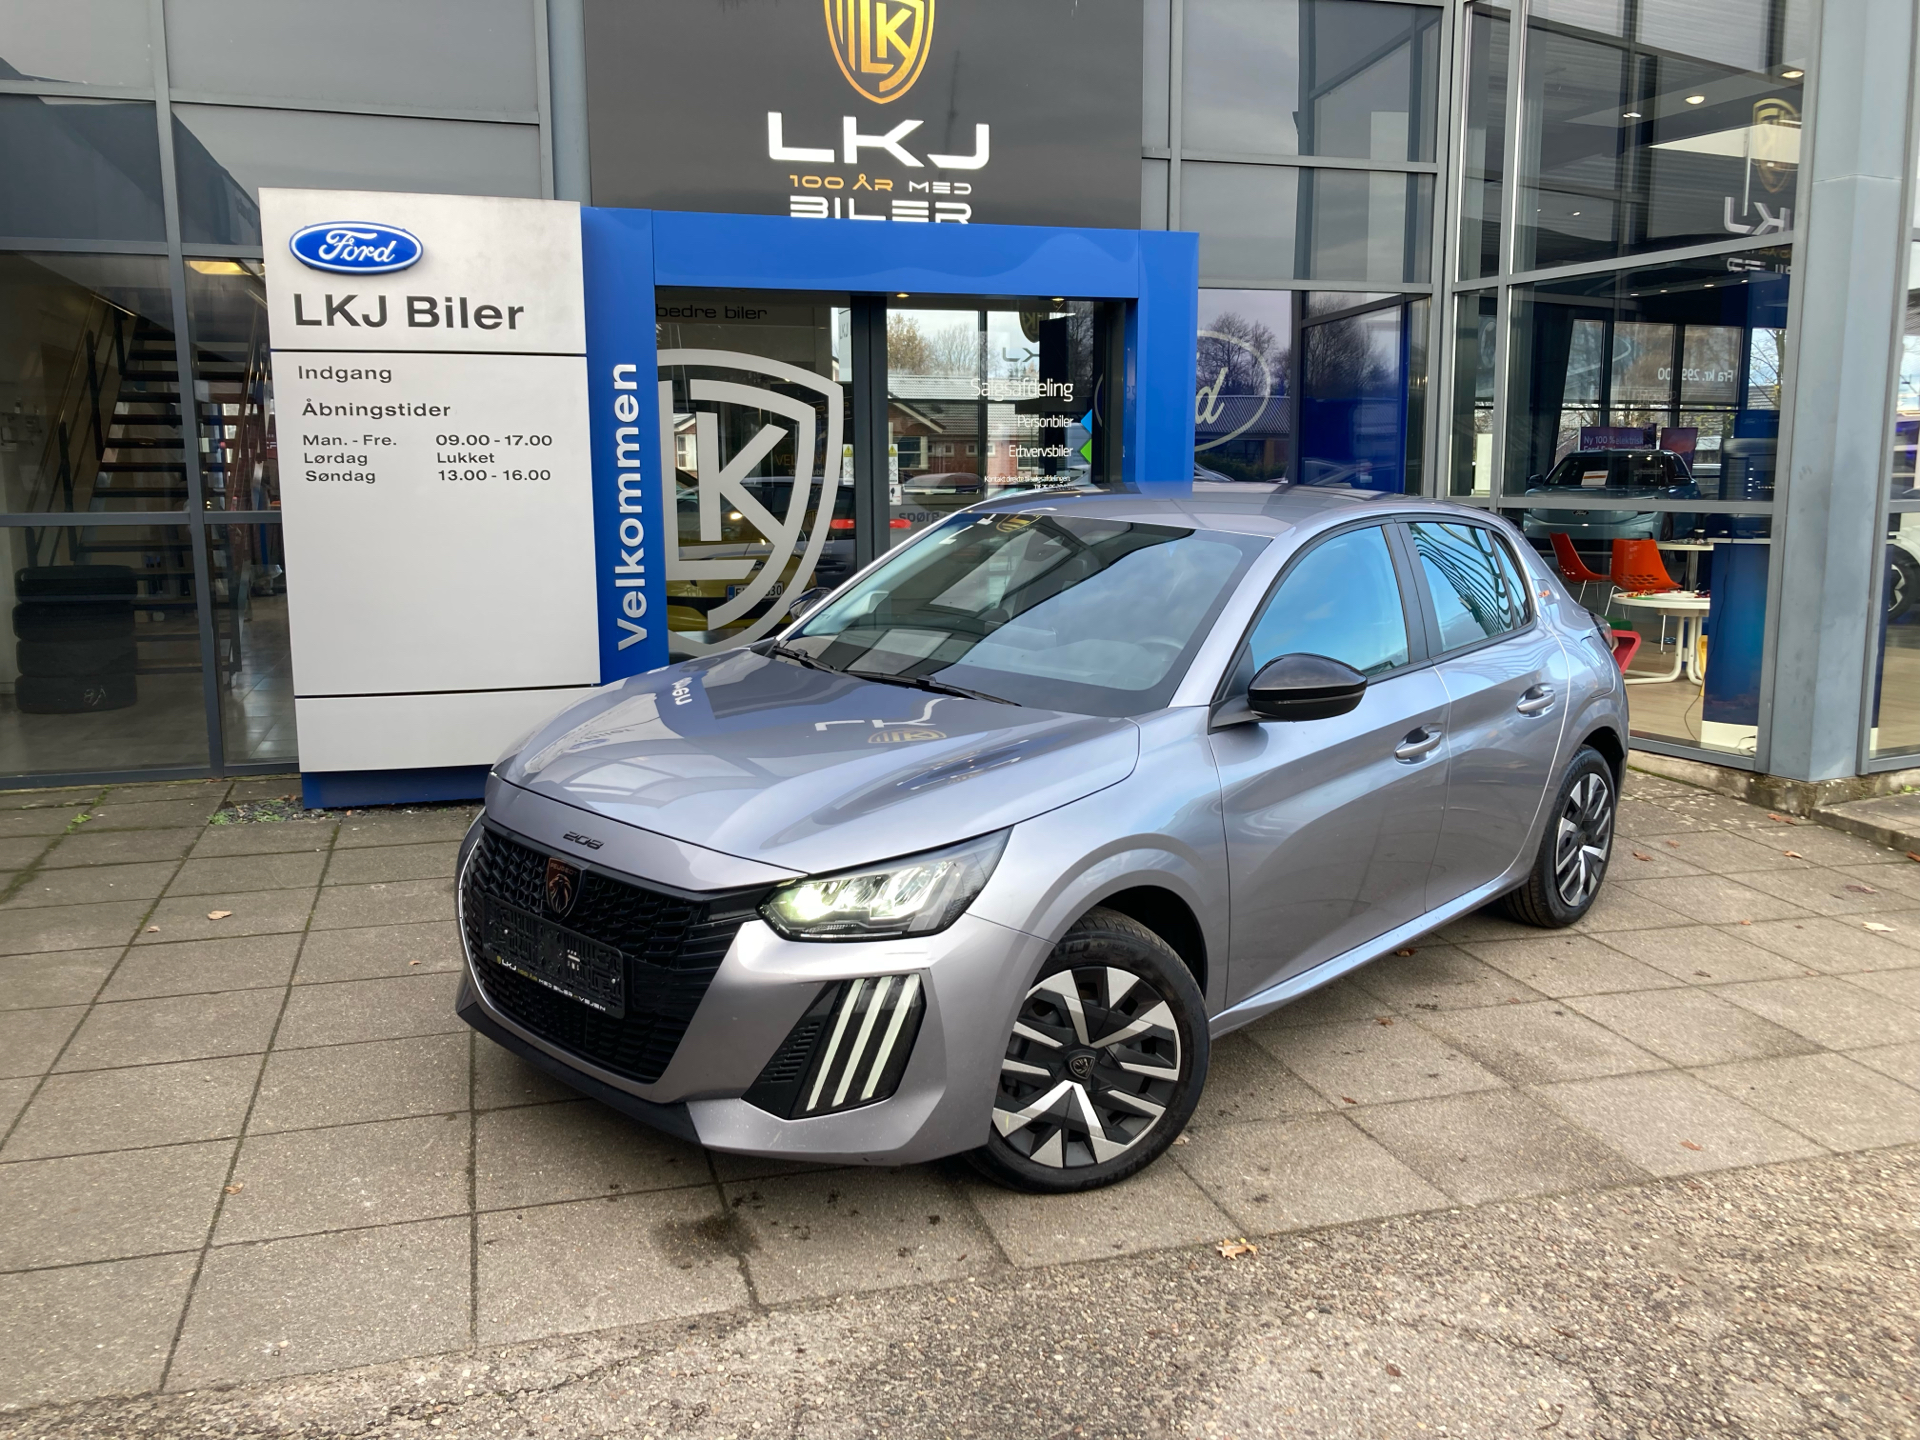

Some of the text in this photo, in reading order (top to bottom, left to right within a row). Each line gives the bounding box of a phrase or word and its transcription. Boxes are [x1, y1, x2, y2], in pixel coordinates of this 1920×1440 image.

[767, 110, 990, 170] LKJ
[789, 173, 972, 195] 100 ÅR MED
[790, 195, 972, 224] BILER
[319, 228, 398, 265] Ford
[293, 293, 525, 331] LKJ Biler
[656, 304, 768, 320] bedre biler
[298, 365, 393, 383] Indgang
[969, 377, 1074, 402] Salgsafdeling
[302, 397, 451, 420] Åbningstider
[1017, 414, 1074, 428] Personbiler
[302, 434, 349, 447] Man.
[363, 434, 397, 447] Fre.
[435, 434, 491, 447] 09.00
[504, 434, 553, 447] 17.00
[303, 452, 496, 467] Lørdag Lukket
[1008, 445, 1074, 458] Erhvervsbiler
[305, 469, 376, 484] Søndag
[438, 469, 488, 482] 13.00
[502, 469, 552, 482] 16.00
[612, 363, 648, 651] Velkommen
[562, 830, 605, 851] 208
[501, 958, 517, 971] LKJ
